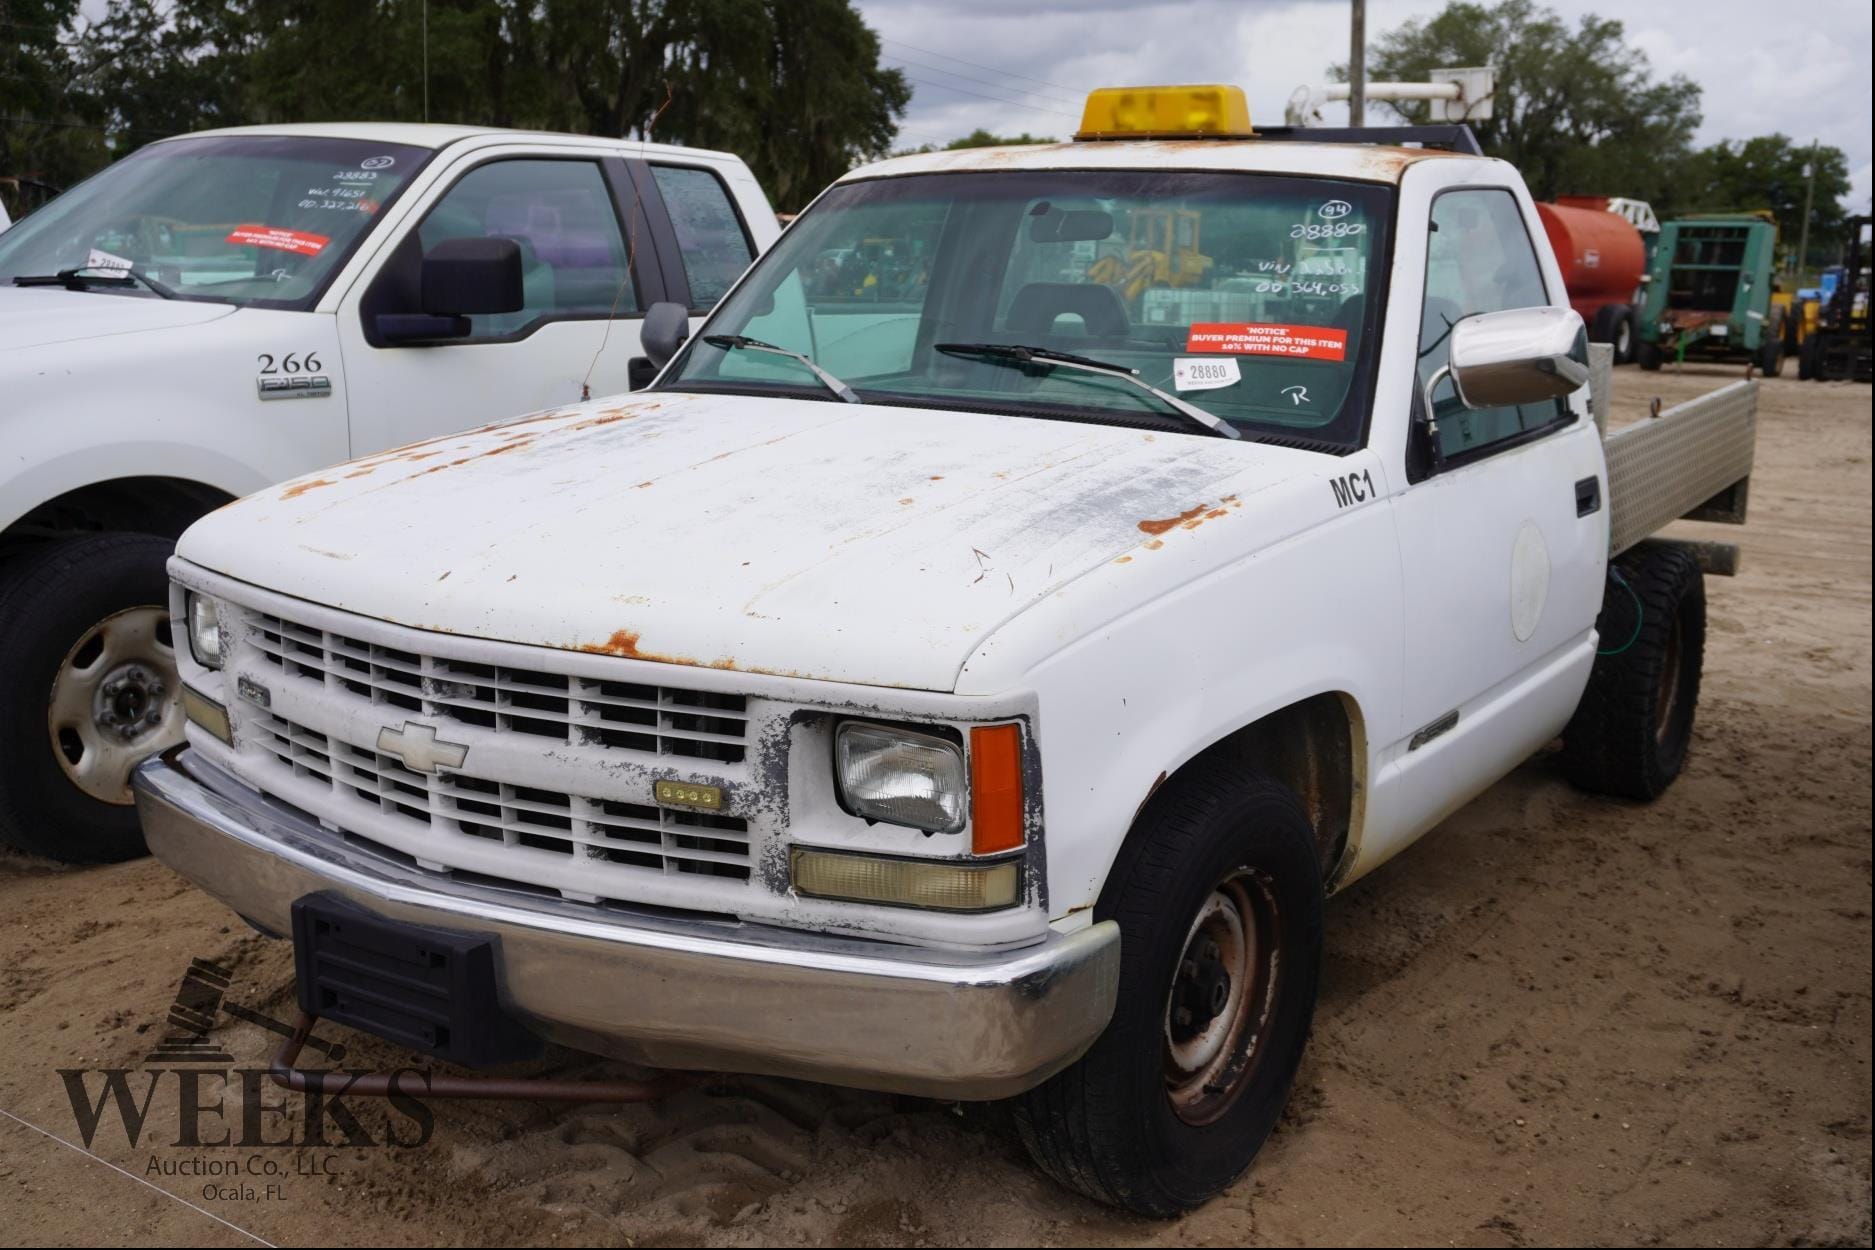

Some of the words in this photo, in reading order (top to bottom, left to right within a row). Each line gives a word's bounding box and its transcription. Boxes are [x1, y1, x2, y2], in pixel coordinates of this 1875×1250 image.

[1324, 204, 1347, 216] 94
[1290, 222, 1362, 240] 28880
[1192, 334, 1224, 342] BUYER
[1225, 335, 1271, 343] PREMIUM
[1273, 336, 1293, 344] FOR
[1294, 338, 1317, 346] THIS
[1318, 339, 1343, 349] ITEM
[1289, 346, 1310, 354] CAP
[257, 351, 322, 374] 266
[1190, 365, 1226, 379] 28880
[1281, 385, 1311, 406] R
[1329, 468, 1376, 508] MC1
